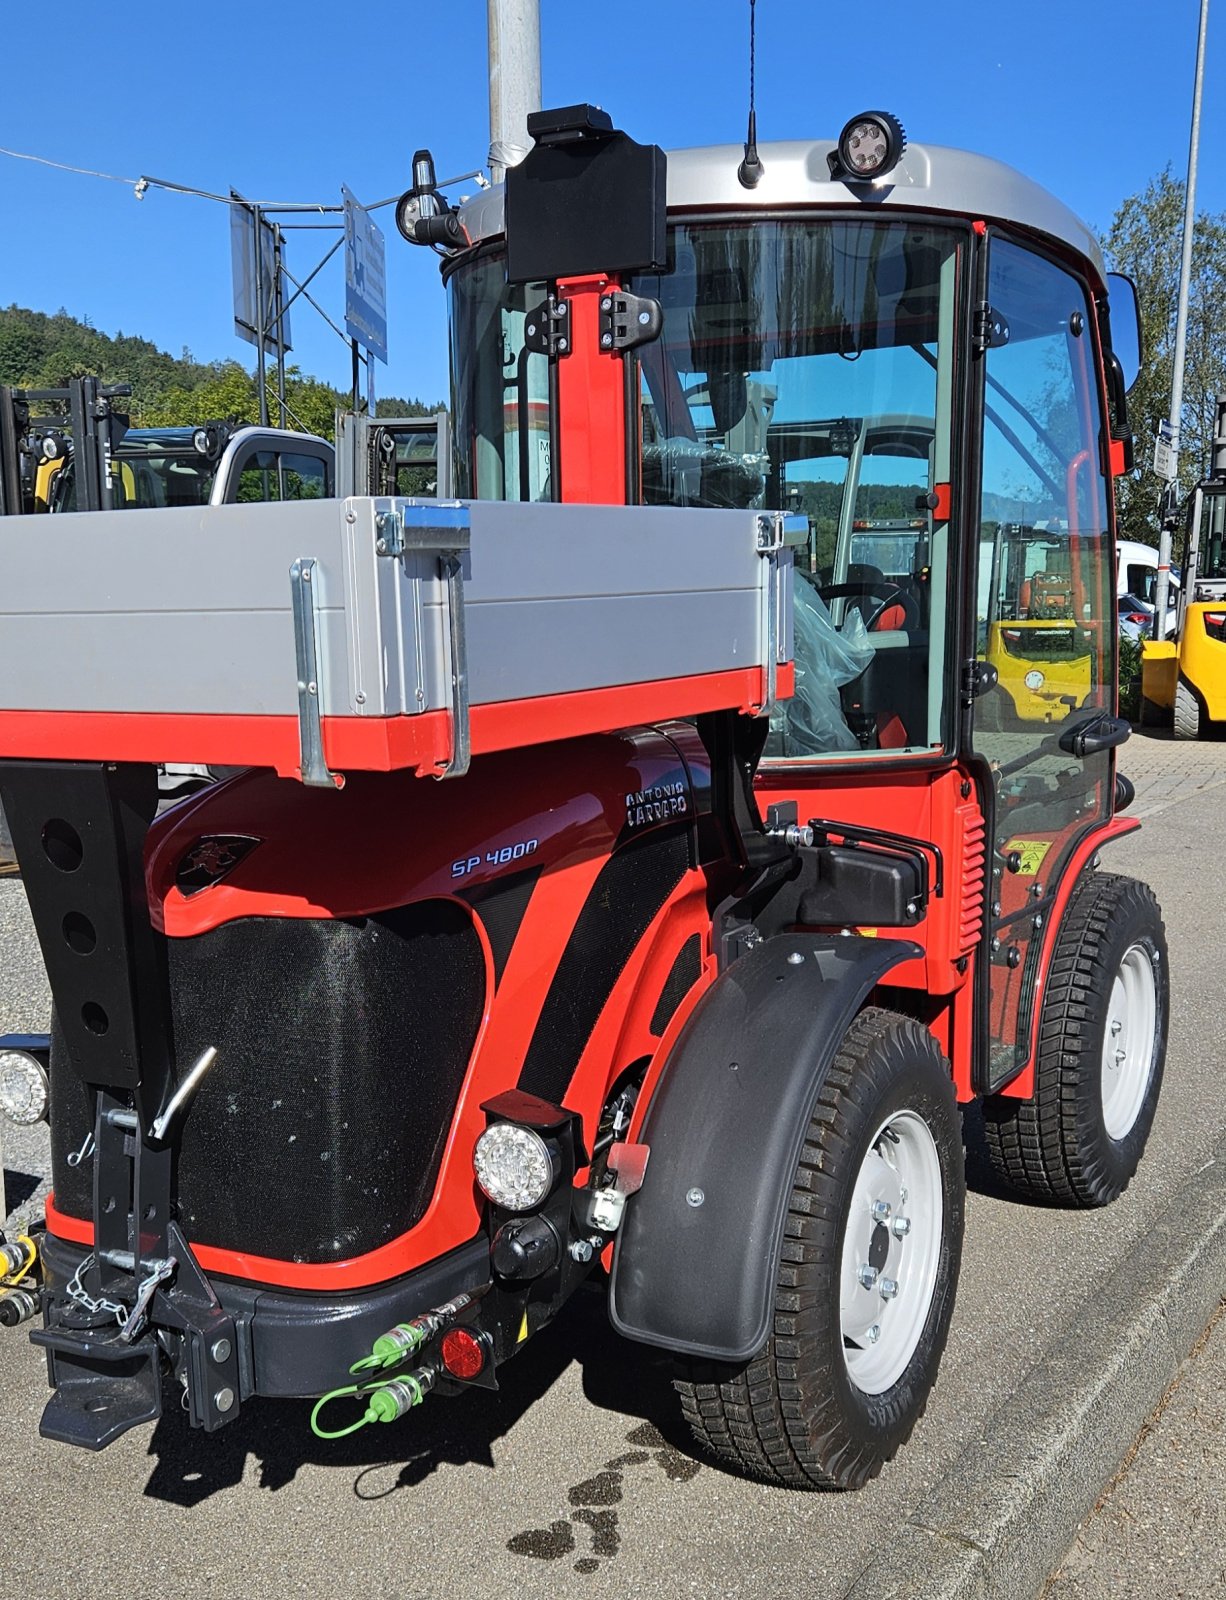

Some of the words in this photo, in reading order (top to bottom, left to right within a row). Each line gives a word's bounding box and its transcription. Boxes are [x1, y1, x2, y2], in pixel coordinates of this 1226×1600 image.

[103, 437, 112, 489] STILL
[626, 782, 684, 807] ANTONIO
[627, 795, 687, 827] CARRARO
[451, 856, 481, 878] SP
[486, 839, 538, 865] 4800
